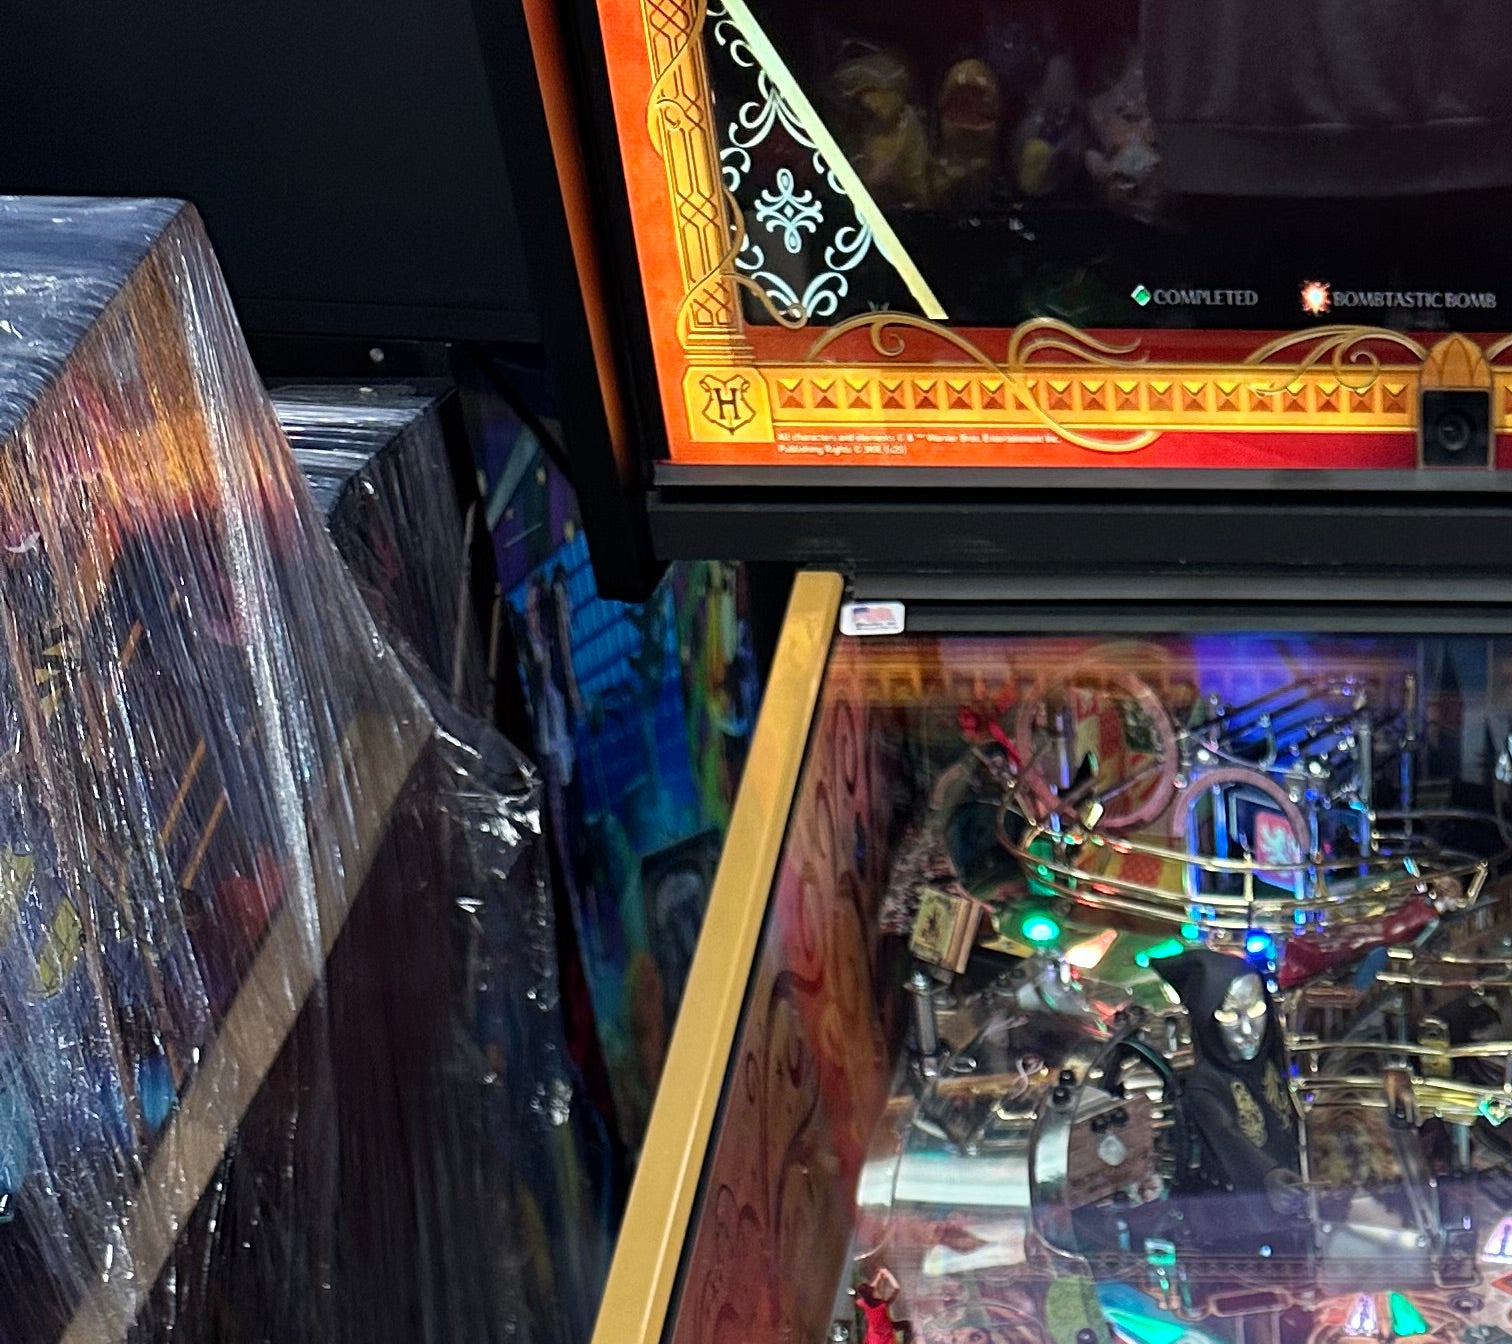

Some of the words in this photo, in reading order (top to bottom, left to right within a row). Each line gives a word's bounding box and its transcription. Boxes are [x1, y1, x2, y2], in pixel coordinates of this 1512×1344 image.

[1153, 289, 1259, 306] COMPLETED
[1333, 291, 1444, 308] BOMBTASTIC
[1448, 292, 1497, 309] BOMB
[713, 387, 741, 419] H
